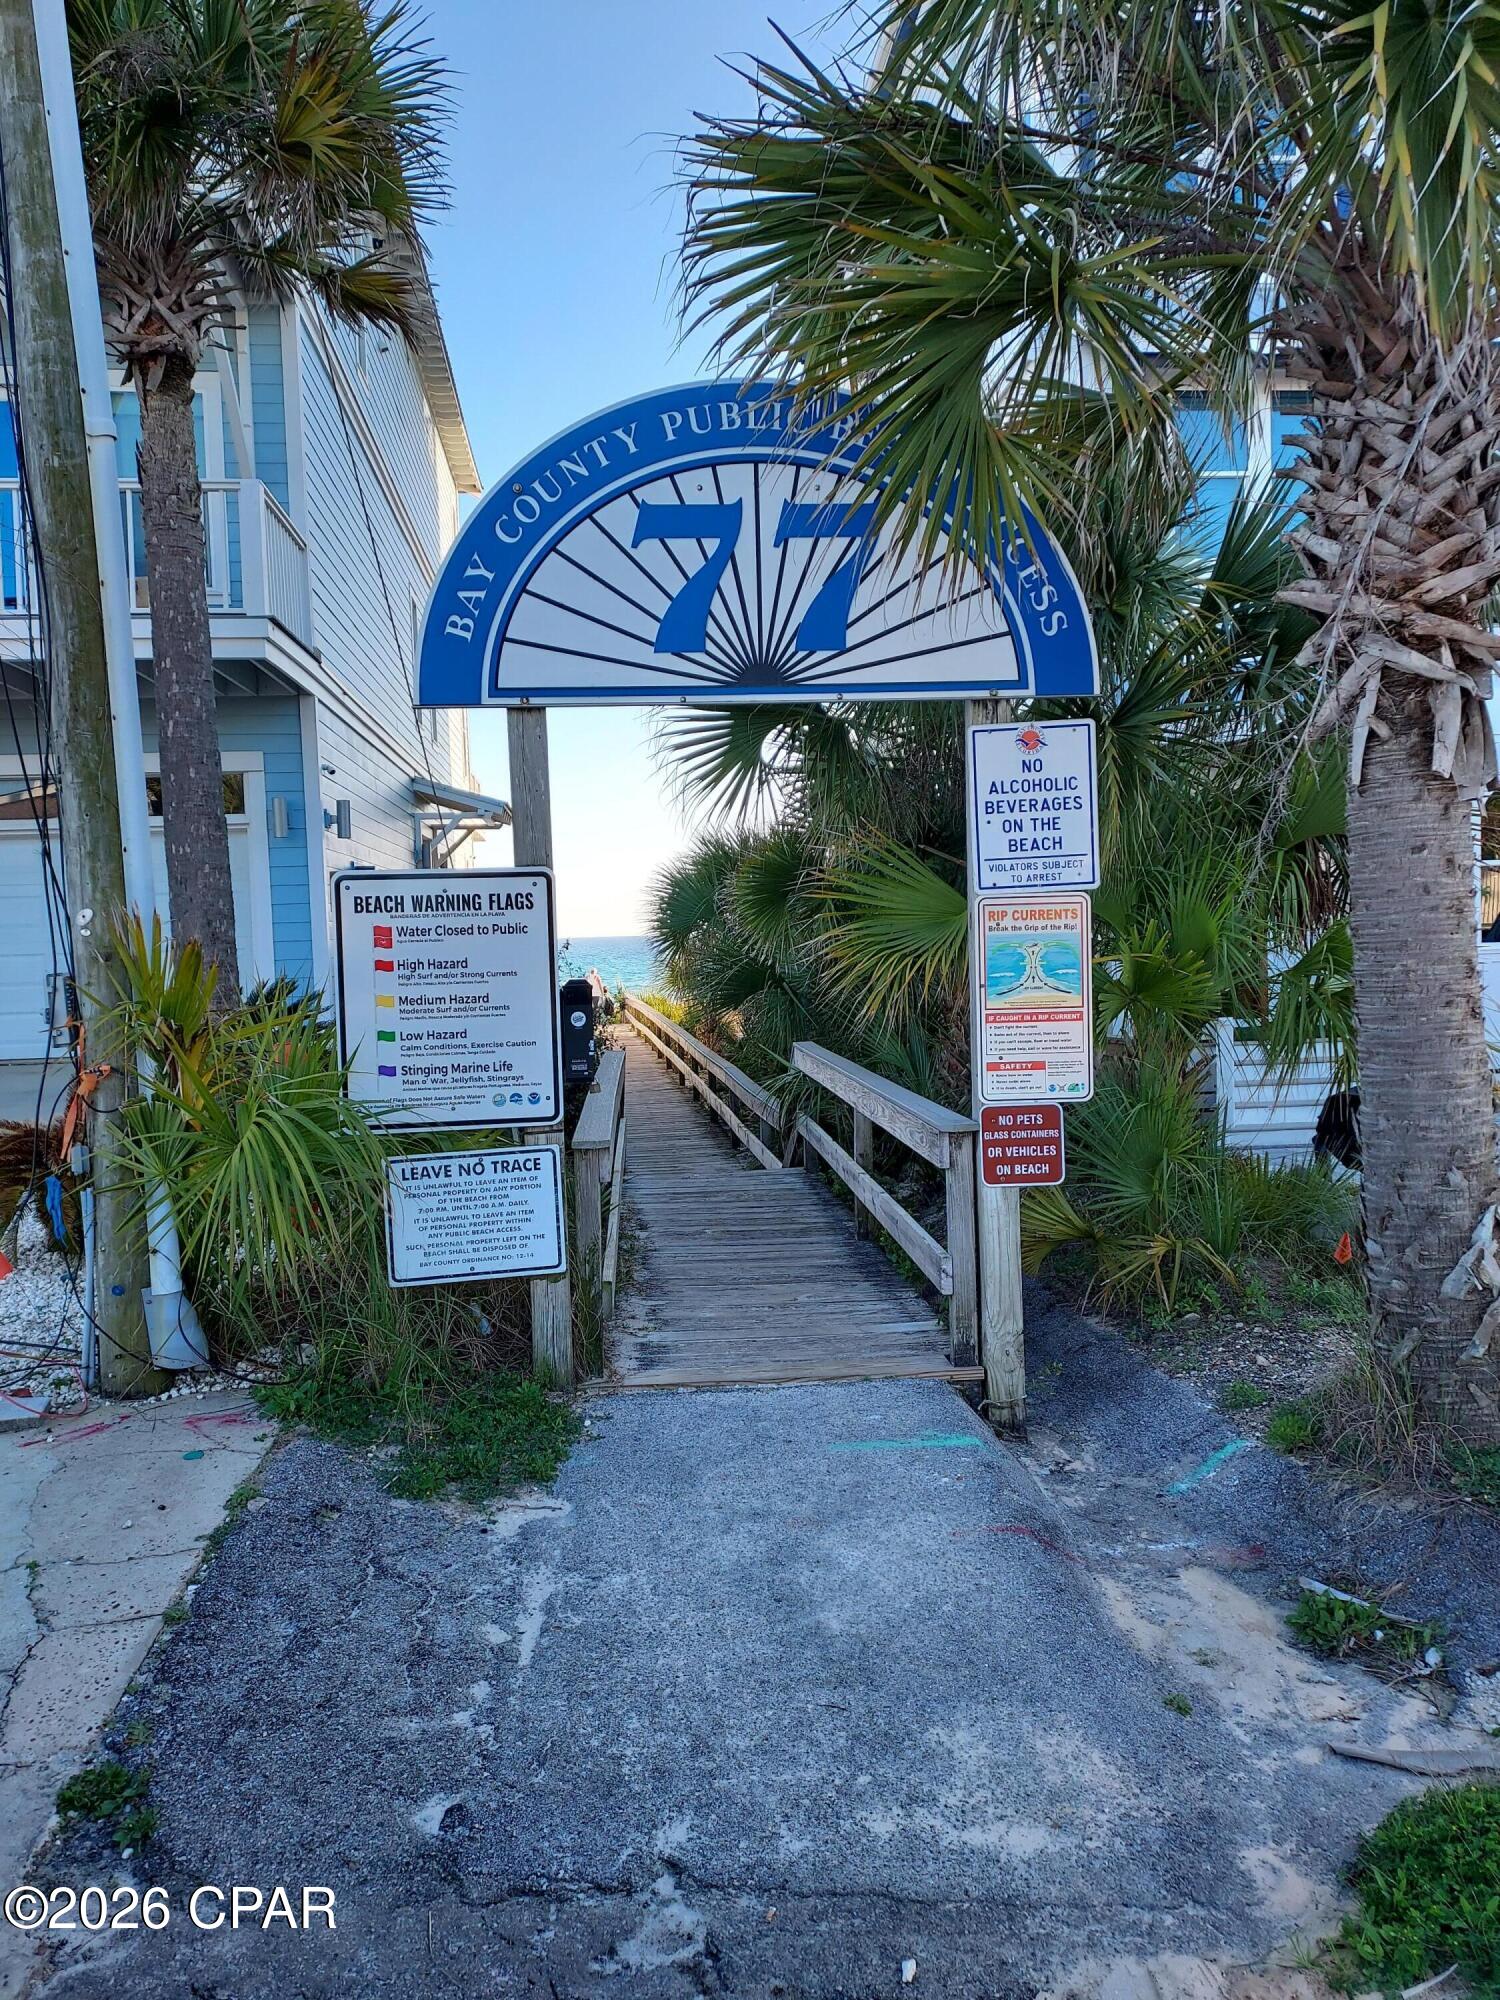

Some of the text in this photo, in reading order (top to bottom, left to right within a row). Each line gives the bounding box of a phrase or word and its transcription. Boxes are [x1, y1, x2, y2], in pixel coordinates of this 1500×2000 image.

[444, 551, 496, 643] BAY
[494, 421, 641, 544] COUNTY
[630, 496, 881, 653] 77
[1022, 758, 1043, 774] NO
[988, 776, 1078, 795] ALCOHOLIC
[985, 795, 1083, 815] BEVERAGES
[1002, 816, 1062, 834] ON THE
[1008, 836, 1063, 852] BEACH
[988, 860, 1084, 873] VIOLATORS SUBJECT
[1012, 872, 1062, 883] TO ARREST
[354, 892, 534, 914] BEACH WARNING FLAGS
[988, 909, 1078, 922] RIP CURRENTS
[396, 922, 528, 937] Water Closed to Public
[988, 924, 1008, 932] Break
[397, 956, 468, 973] High Hazard
[398, 973, 415, 981] High
[399, 992, 489, 1006] Medium Hazard
[400, 1028, 467, 1041] Low Hazard
[401, 1060, 513, 1077] Stinging Marine Life
[999, 1114, 1043, 1126] NO PETS
[984, 1129, 1059, 1140] GLASS CONTAINERS
[988, 1145, 1056, 1157] OR VEHICLES
[402, 1158, 541, 1181] LEAVE NO TRACE
[996, 1164, 1049, 1175] ON BEACH
[423, 1182, 463, 1190] UNLAWFUL
[483, 1244, 517, 1252] DISPOSED
